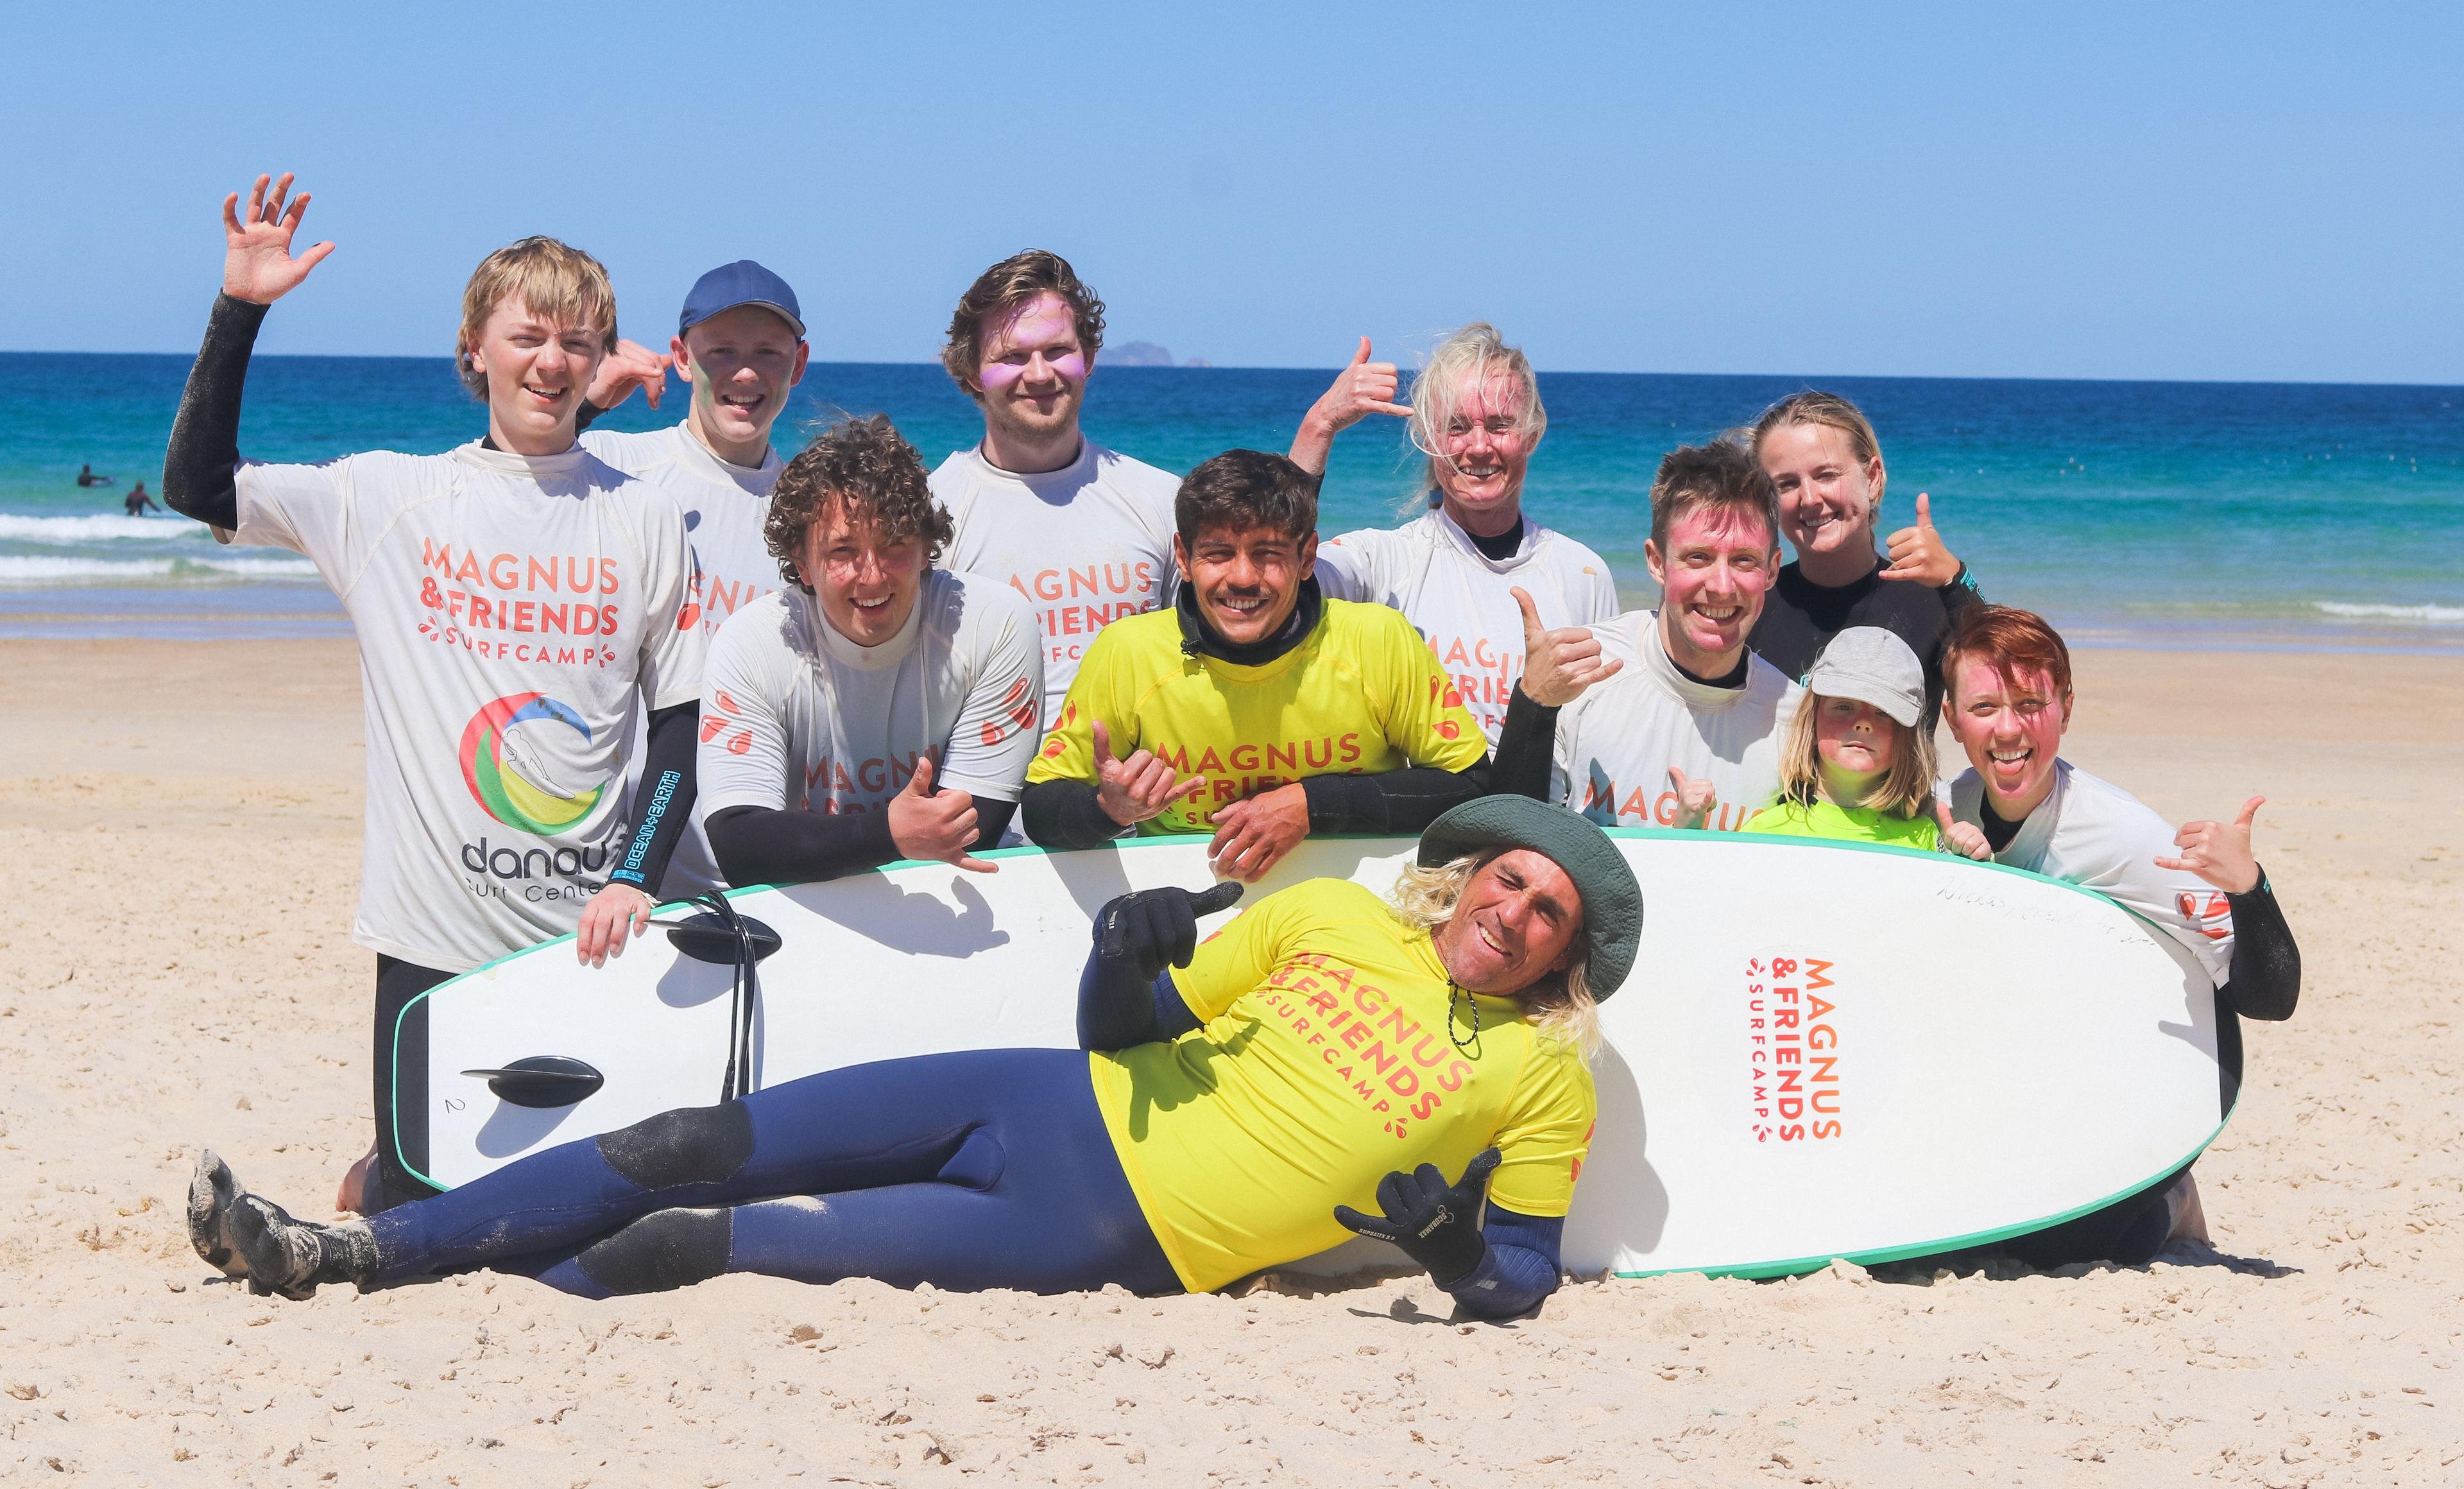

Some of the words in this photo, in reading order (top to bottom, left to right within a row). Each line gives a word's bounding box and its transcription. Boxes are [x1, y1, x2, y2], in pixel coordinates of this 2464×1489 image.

[424, 537, 619, 595] MAGNUS
[445, 626, 595, 666] SURFCAMP
[1157, 733, 1362, 774] MAGNUS
[624, 770, 681, 870] OCEAN+EARTH
[525, 881, 602, 902] Cente
[1772, 957, 1798, 980] &
[1288, 951, 1474, 1092] MAGNUS
[1749, 983, 1769, 1118] SURFCAMP
[1804, 958, 1842, 1140] MAGNUS
[1266, 994, 1391, 1113] SURFCAMP
[1773, 987, 1805, 1142] FRIENDS
[1358, 1228, 1386, 1240] SUPRATEX
[1418, 1212, 1448, 1239] SCUBAMAX
